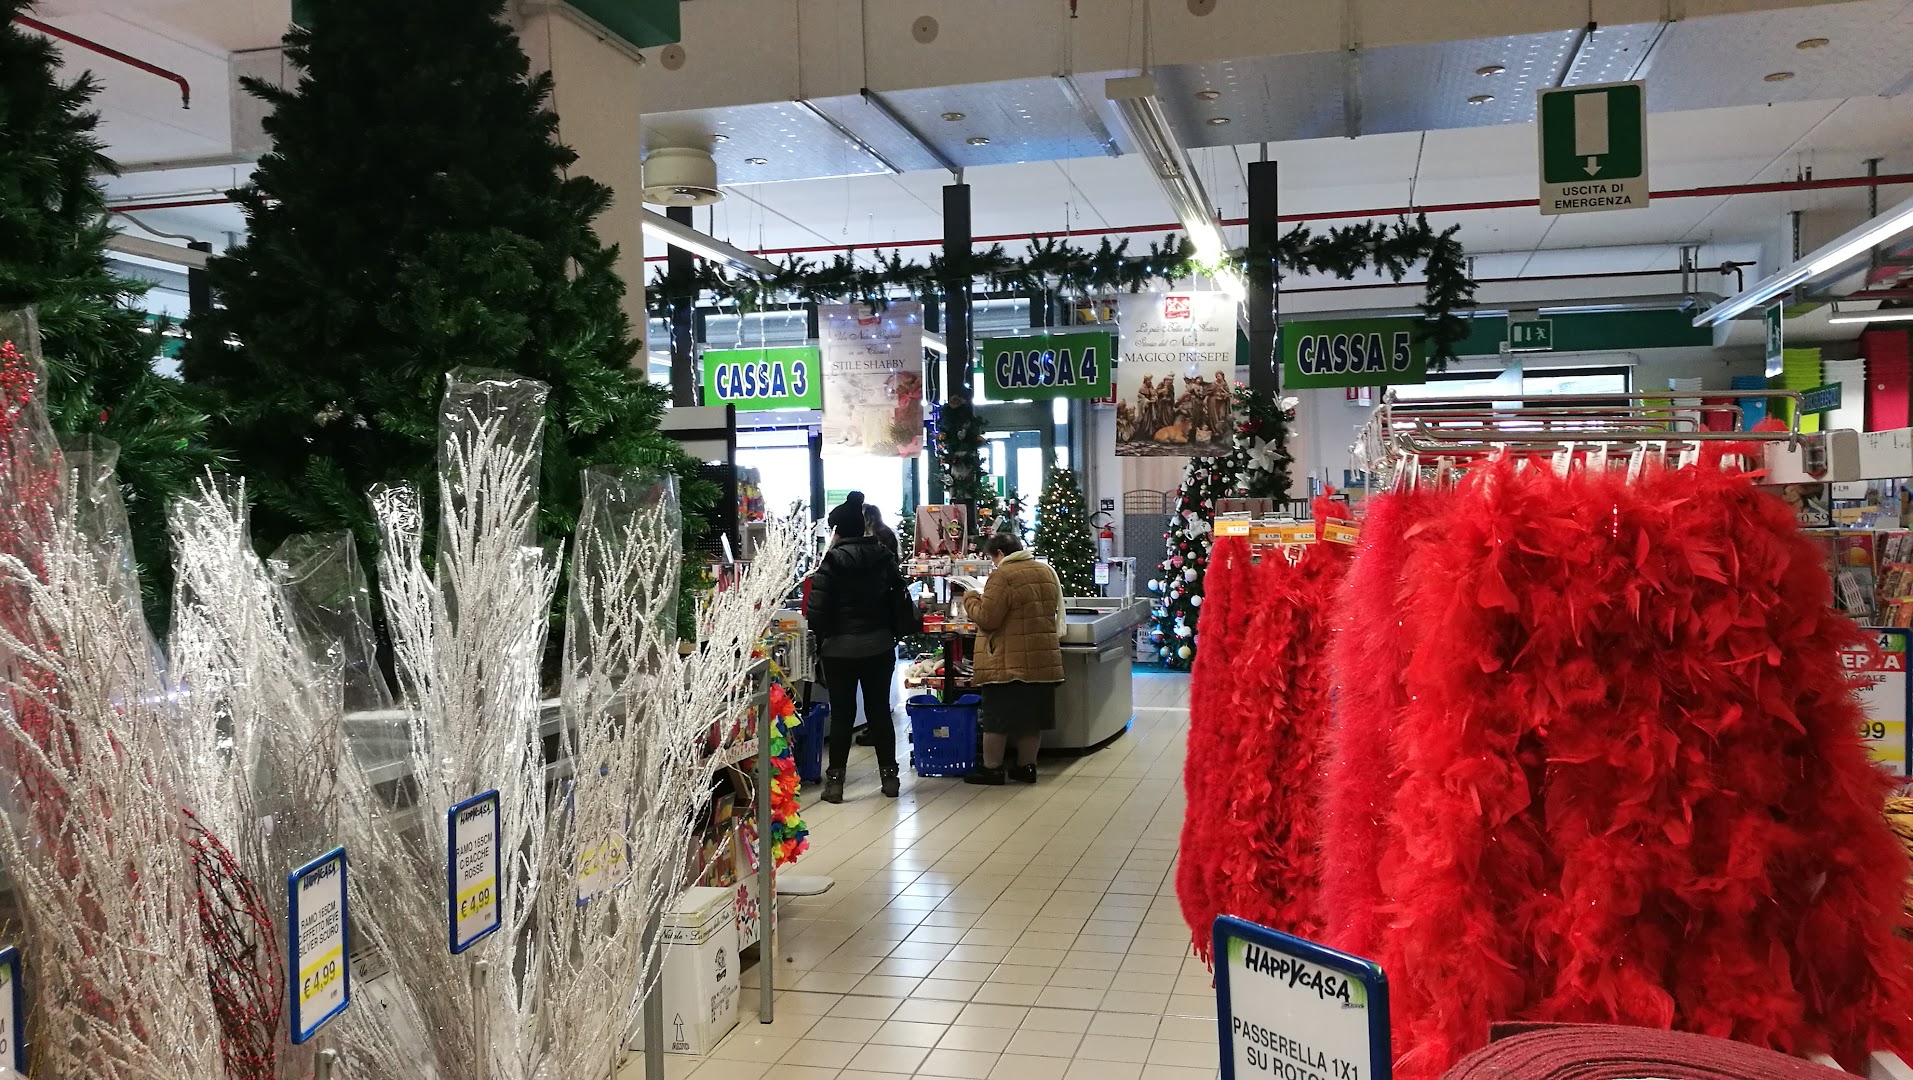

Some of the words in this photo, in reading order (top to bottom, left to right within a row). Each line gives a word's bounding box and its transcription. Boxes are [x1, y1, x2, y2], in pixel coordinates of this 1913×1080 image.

[1555, 195, 1632, 209] EMERGENZA
[1562, 185, 1607, 196] USCITA
[1611, 183, 1624, 193] DI
[833, 360, 862, 371] STILE
[864, 359, 906, 370] SHABBY
[1125, 352, 1176, 363] MAGICO
[1179, 351, 1230, 362] PRESEPE
[1297, 332, 1387, 375] CASSA
[1392, 331, 1411, 372] 5
[715, 360, 789, 400] CASSA
[791, 359, 808, 397] 3
[996, 348, 1076, 389] CASSA
[1080, 347, 1098, 385] 4
[456, 841, 473, 858] RAMO
[464, 862, 484, 881] ROSSE
[461, 900, 467, 919] €
[470, 887, 490, 914] 4,99
[301, 911, 318, 930] RAMO
[326, 910, 339, 928] NEVE
[299, 936, 319, 959] SILVER
[320, 923, 339, 944] SCURO
[304, 977, 311, 999] €
[313, 960, 336, 993] 4,99
[1233, 1016, 1328, 1073] PASSERELLA
[1331, 1058, 1358, 1080] 1X1
[1247, 1046, 1268, 1071] SU
[1273, 1057, 1325, 1080] ROT
